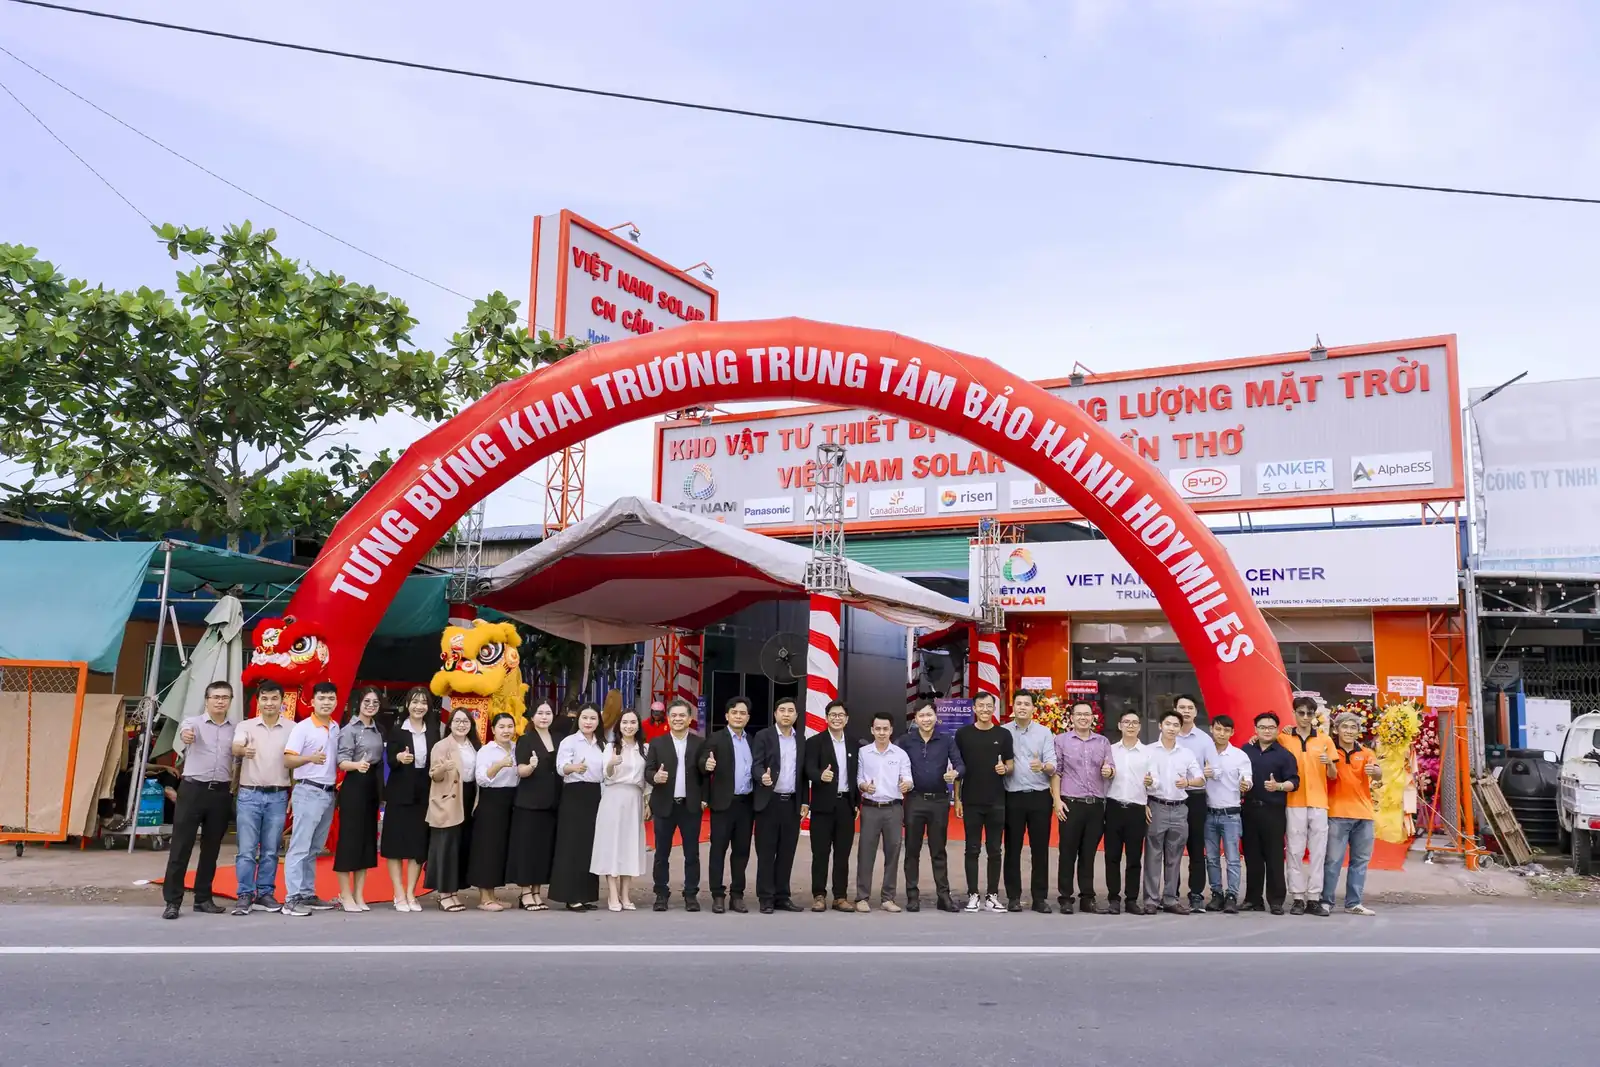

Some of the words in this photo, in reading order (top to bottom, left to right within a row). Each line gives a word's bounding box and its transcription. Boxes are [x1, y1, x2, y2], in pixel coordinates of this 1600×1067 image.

[572, 246, 612, 282] VIỆT
[618, 270, 653, 304] NAM
[591, 296, 617, 323] CN
[1119, 383, 1233, 422] LƯỢNG
[1245, 371, 1323, 412] MẶT
[1337, 356, 1431, 399] TRỜI
[669, 436, 716, 461] KHO
[724, 427, 769, 461] VẬT
[777, 421, 814, 452] TƯ
[1173, 424, 1245, 460] THƠ
[777, 459, 834, 492] VIỆT
[844, 457, 903, 484] NAM
[912, 450, 1006, 480] SOLAR
[1263, 460, 1327, 477] ANKER
[1377, 461, 1432, 475] AlphaESS
[1187, 475, 1223, 487] BYD
[1485, 468, 1526, 491] CÔNG
[1530, 470, 1550, 489] TY
[1555, 467, 1598, 488] TNHH
[329, 508, 419, 601] TƯNG
[403, 432, 506, 520] BỪNG
[498, 385, 593, 451] KHAI
[591, 349, 738, 410] TRƯƠNG
[746, 346, 868, 388] TRUNG
[879, 357, 957, 411] TÂM
[962, 384, 1034, 441] BẢO
[1030, 418, 1134, 507] HÀNH
[1121, 492, 1255, 664] HOYMILES
[960, 491, 993, 503] risen
[700, 501, 738, 513] NAM
[744, 505, 791, 517] Panasonic
[869, 504, 923, 516] CanadianSolar
[1066, 573, 1104, 586] VIET
[1245, 567, 1325, 581] CENTER
[1016, 586, 1046, 594] NAM
